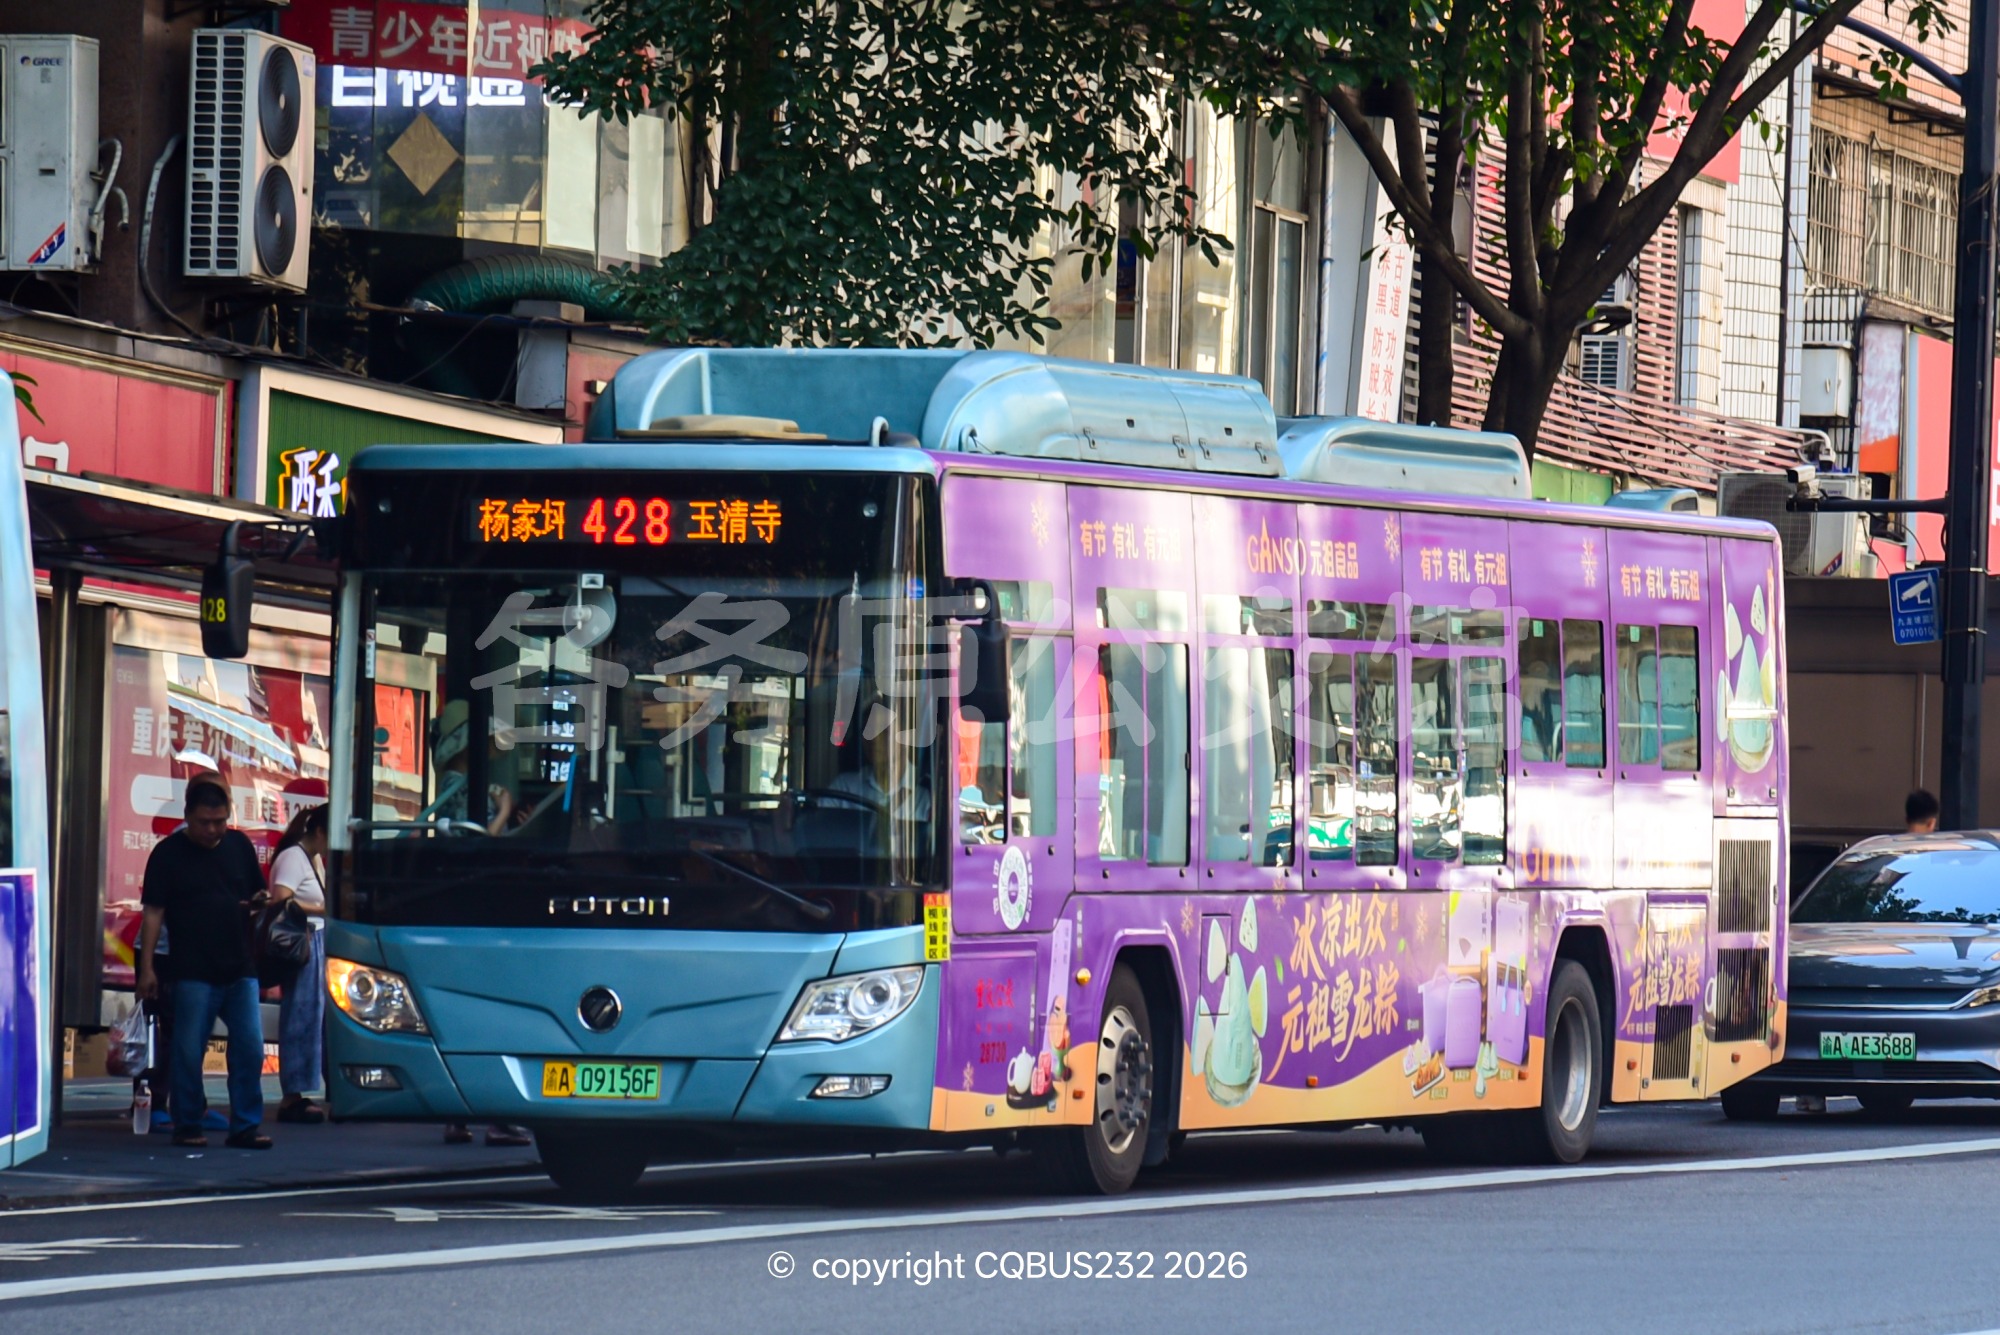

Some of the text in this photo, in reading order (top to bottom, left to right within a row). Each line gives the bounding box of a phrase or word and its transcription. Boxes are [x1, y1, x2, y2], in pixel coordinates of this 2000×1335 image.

[329, 7, 601, 74] 青少年近视防
[479, 498, 781, 543] 杨家坪 428 玉清寺
[1080, 519, 1107, 558] 有节
[1112, 522, 1139, 561] 有礼
[1247, 516, 1359, 579] GANSO 元祖食品
[1420, 547, 1507, 586] 有节 有礼 有元祖
[1620, 564, 1700, 602] 有节 有礼 有元祖
[548, 896, 670, 915] FOTON
[1290, 882, 1388, 980] 冰凉出众
[1851, 1037, 1912, 1056] AE3688
[581, 1066, 657, 1094] 09156F
